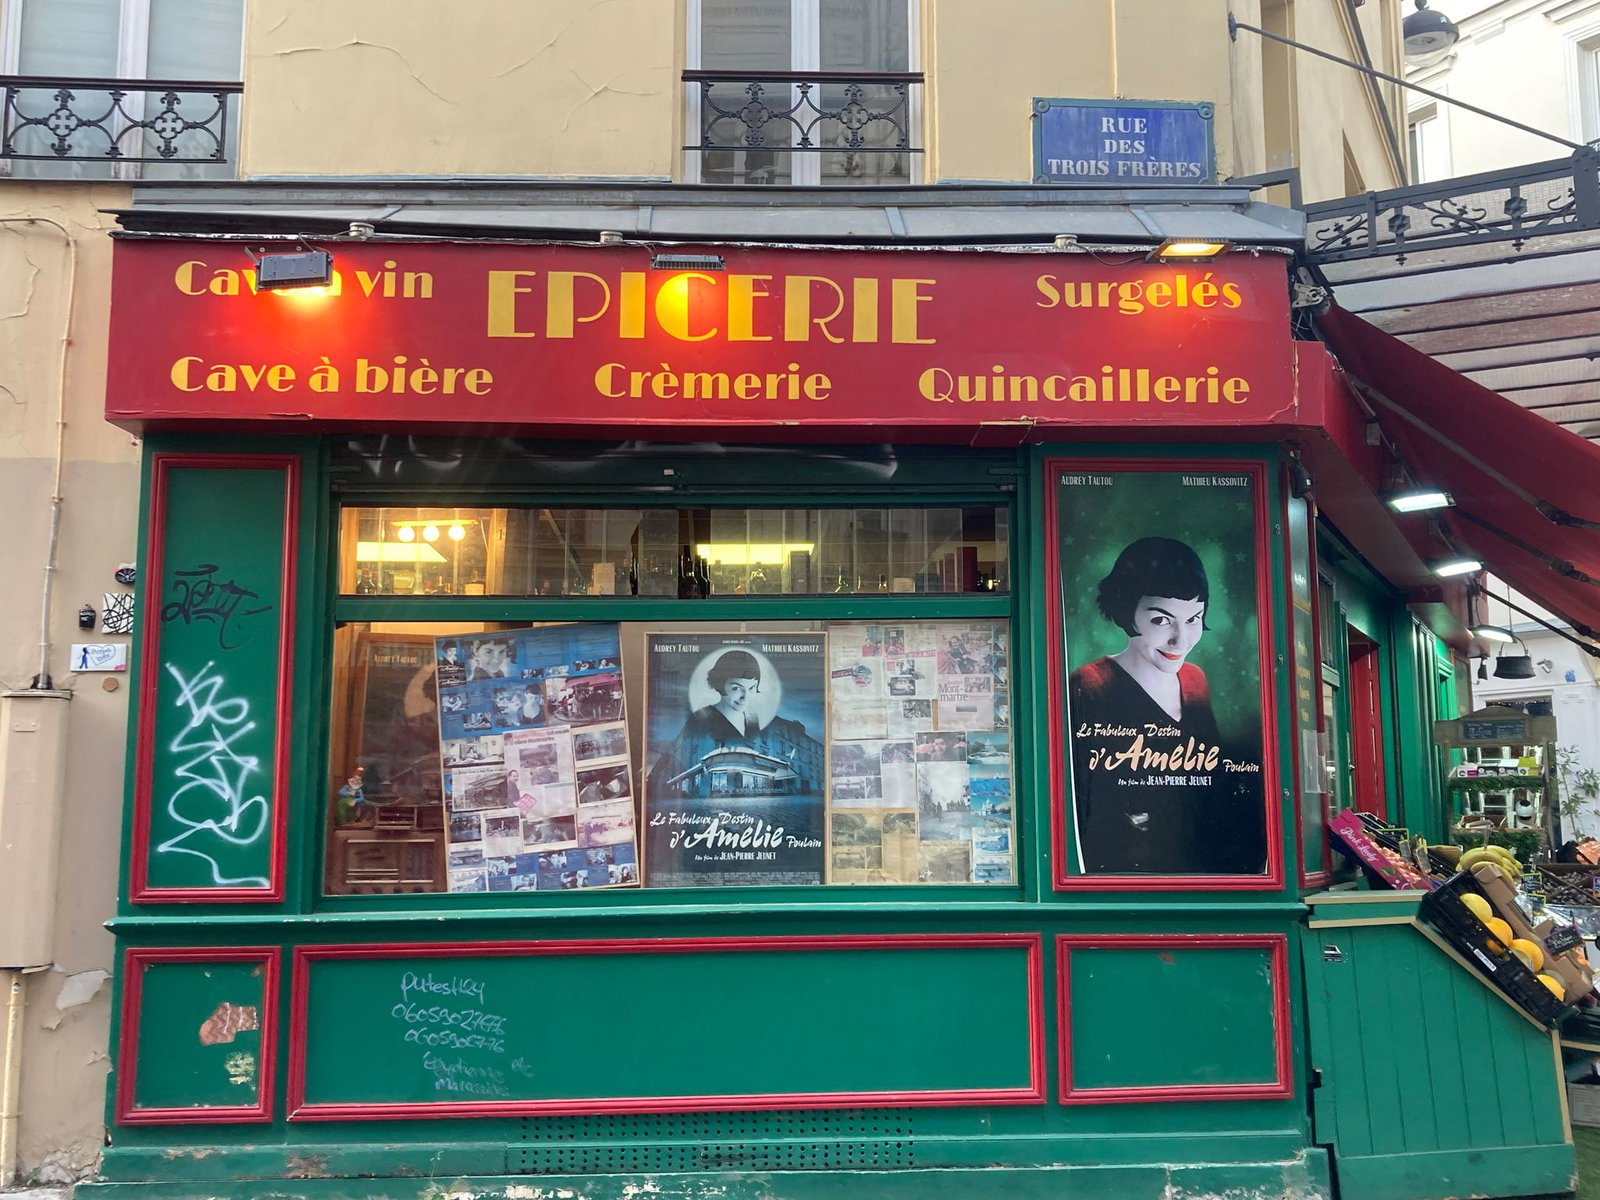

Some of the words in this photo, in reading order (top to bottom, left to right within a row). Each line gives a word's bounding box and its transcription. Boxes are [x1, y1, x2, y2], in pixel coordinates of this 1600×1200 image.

[1101, 117, 1147, 134] RUE
[1103, 140, 1145, 154] DES
[1047, 159, 1110, 176] TROIS
[1117, 156, 1201, 178] FRÈRES
[1036, 272, 1242, 316] Surgelés
[487, 270, 937, 344] EPICERIE
[170, 356, 297, 393] Cave
[308, 357, 340, 393] à
[355, 355, 494, 396] bière
[594, 362, 832, 401] Crèmerie
[918, 364, 1250, 404] Quincaillerie
[1076, 722, 1092, 738] Le
[1094, 723, 1138, 737] Fabuleux
[1144, 723, 1182, 737] Destin
[1222, 759, 1260, 773] Poulain
[1146, 775, 1187, 786] JEAN-PIERRE
[1188, 775, 1213, 786] JEUNET
[650, 812, 666, 827] Le
[669, 812, 711, 825] Fabuleux
[718, 812, 754, 825] Destin
[786, 835, 822, 848] Poulain
[1340, 827, 1361, 846] Pink
[1357, 839, 1377, 862] Lady
[719, 851, 755, 860] JEAN-PIERRE
[756, 851, 776, 860] JEUNET
